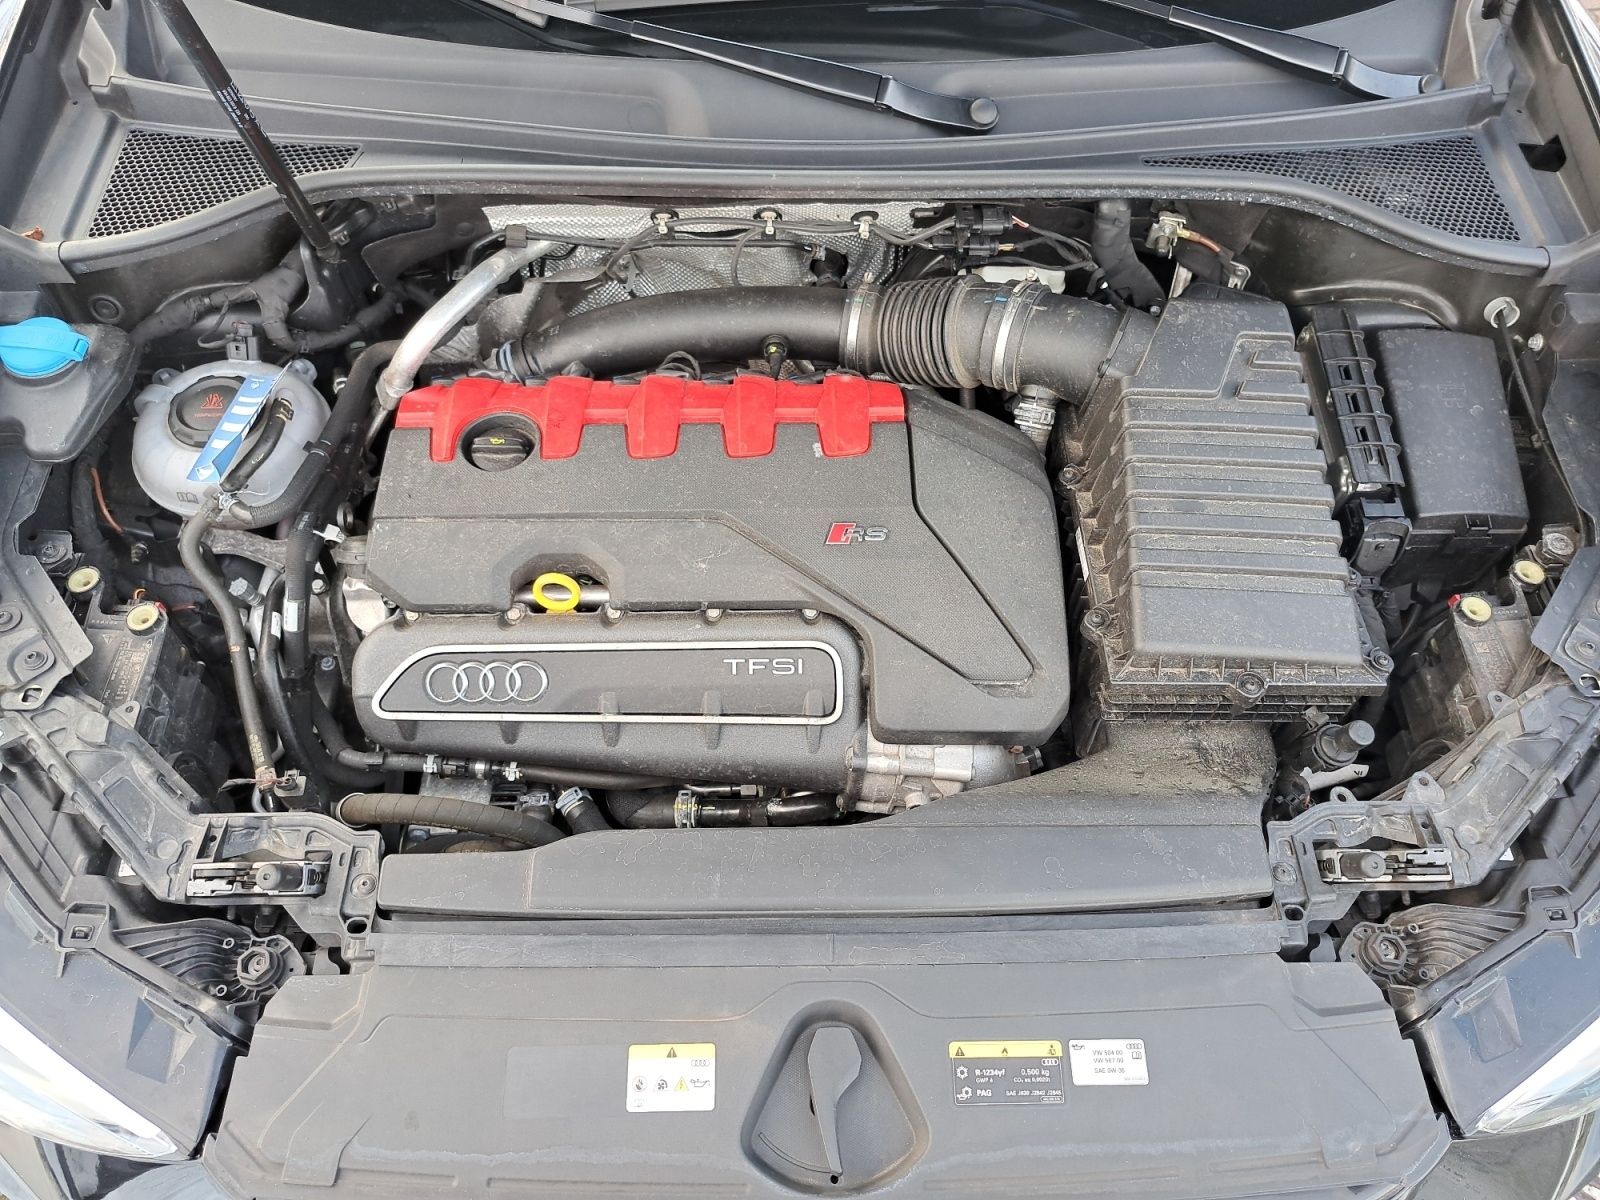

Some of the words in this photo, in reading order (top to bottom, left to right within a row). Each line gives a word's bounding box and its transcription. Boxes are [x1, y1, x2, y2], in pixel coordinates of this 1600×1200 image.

[838, 525, 889, 542] RS
[723, 658, 803, 675] TFSI
[974, 1069, 1005, 1077] R-1234yf
[1020, 1068, 1040, 1076] 0,500
[1041, 1068, 1050, 1077] kg
[976, 1089, 992, 1097] PAG
